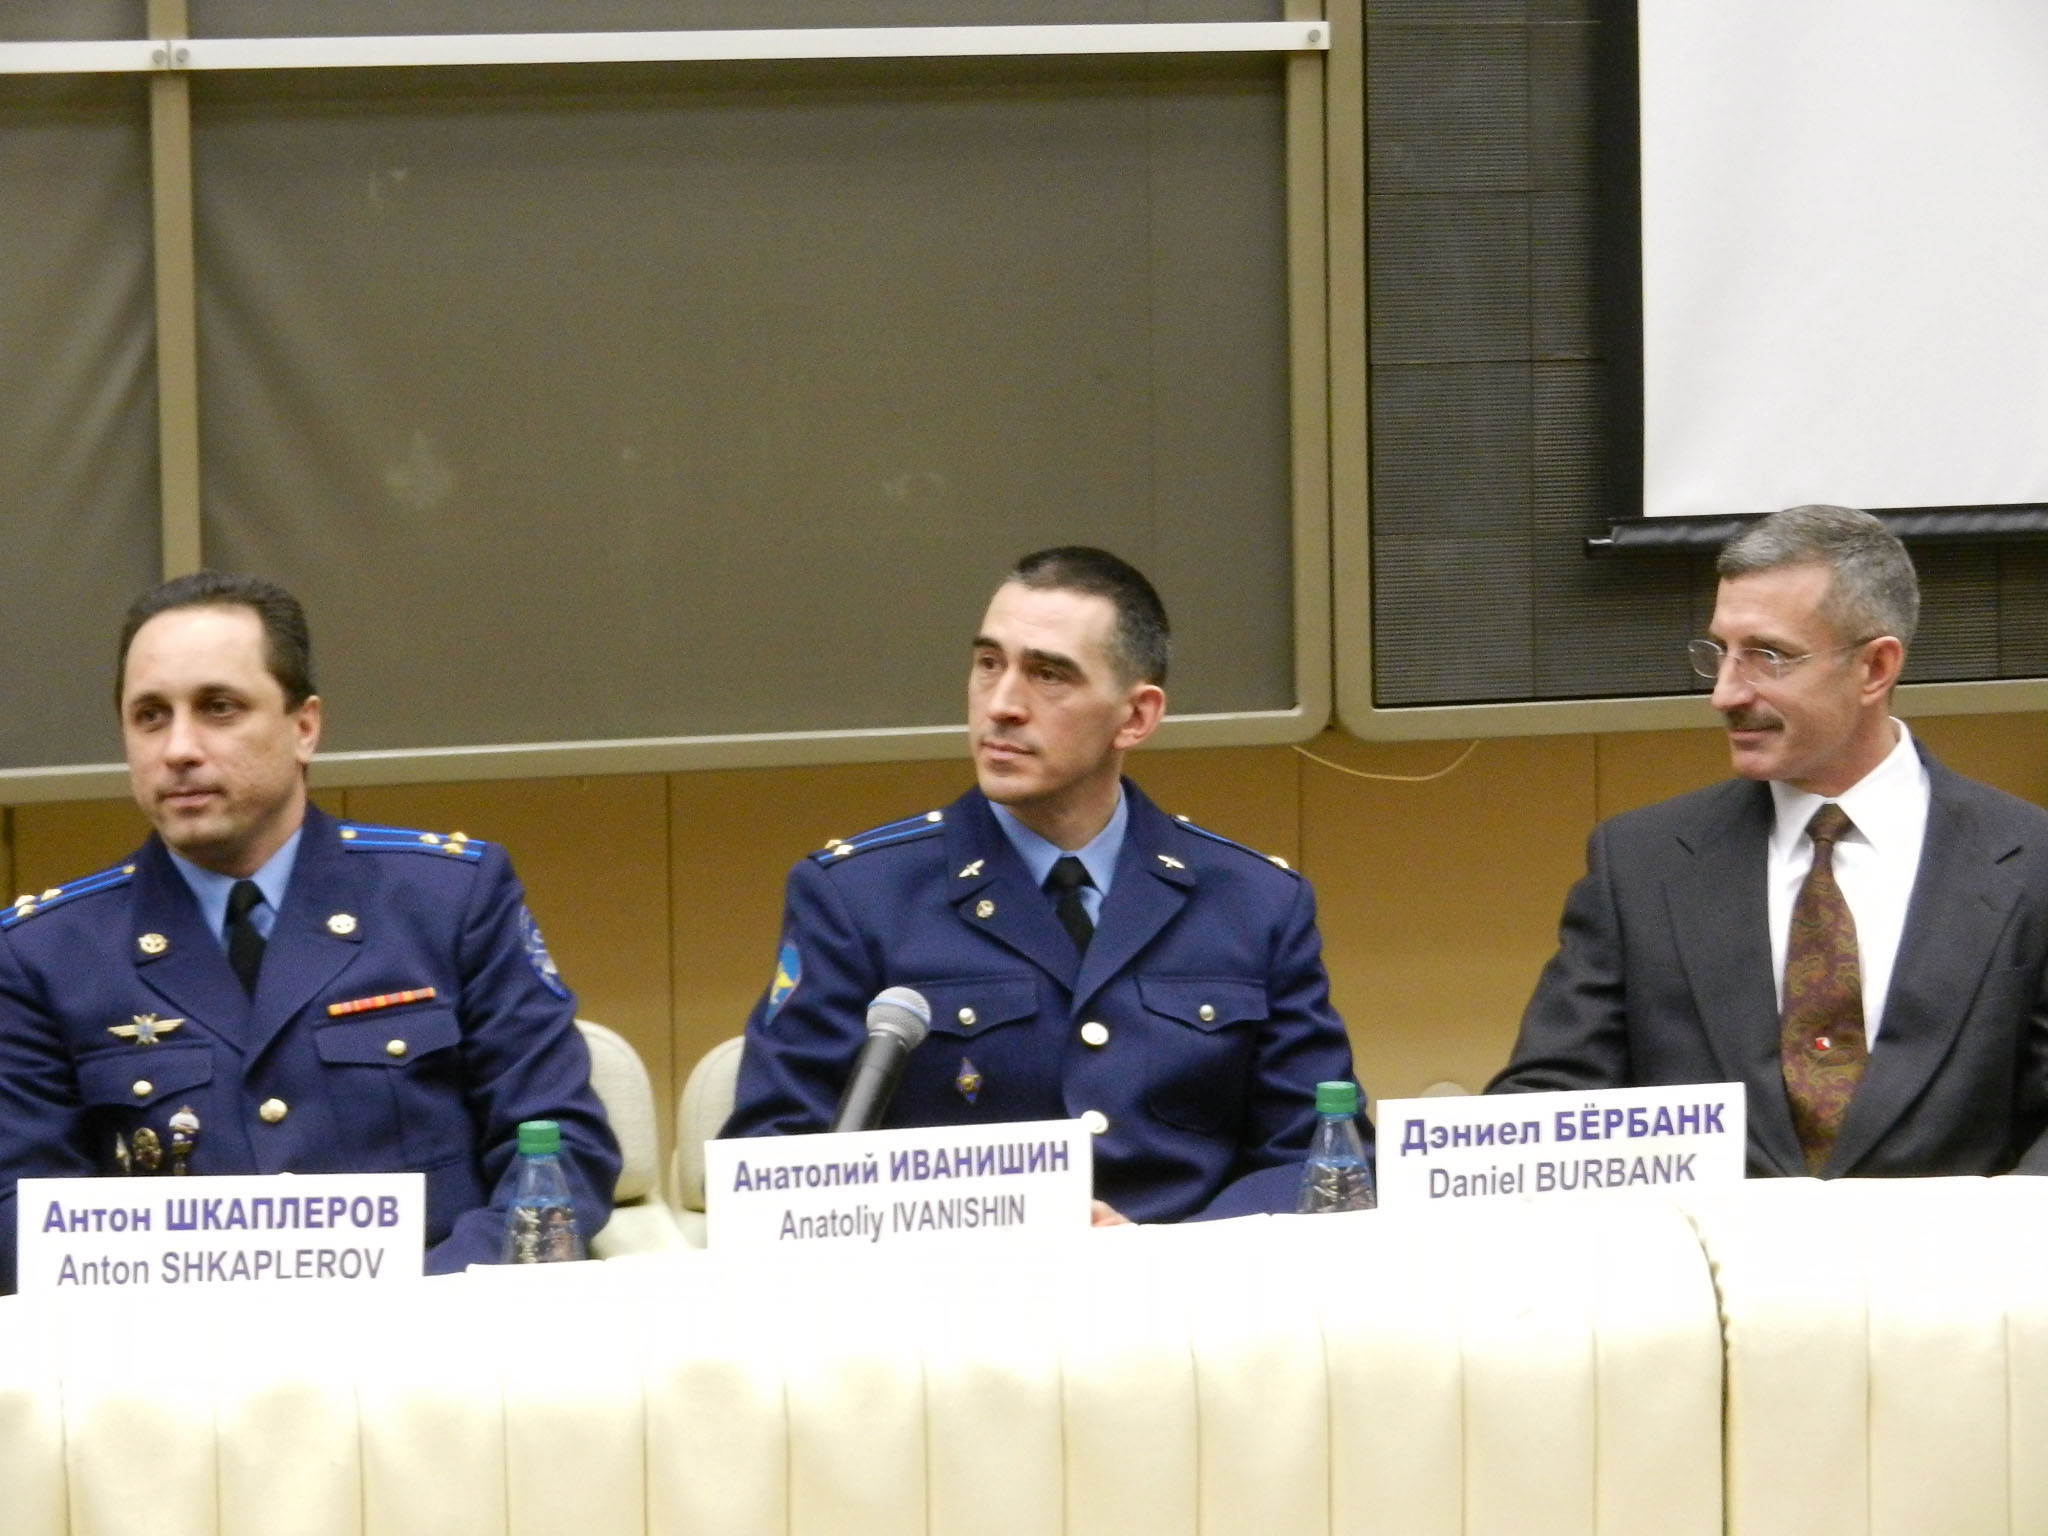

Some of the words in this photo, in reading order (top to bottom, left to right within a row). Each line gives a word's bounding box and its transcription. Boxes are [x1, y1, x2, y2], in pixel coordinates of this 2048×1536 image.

[1400, 1118, 1541, 1156] Дэниел
[1554, 1103, 1725, 1142] БЁРБАНК
[733, 1152, 879, 1192] Анатолий
[890, 1139, 1070, 1183] ИВАНИШИН
[1429, 1163, 1524, 1199] Daniel
[1536, 1153, 1697, 1193] BURBANK
[42, 1200, 151, 1233] Антон
[165, 1195, 399, 1231] ШКАПЛЕРОВ
[779, 1204, 884, 1243] Anatoliy
[892, 1194, 1025, 1234] IVANISHIN
[57, 1253, 149, 1286] Anton
[161, 1247, 385, 1284] SHKAPLEROV
